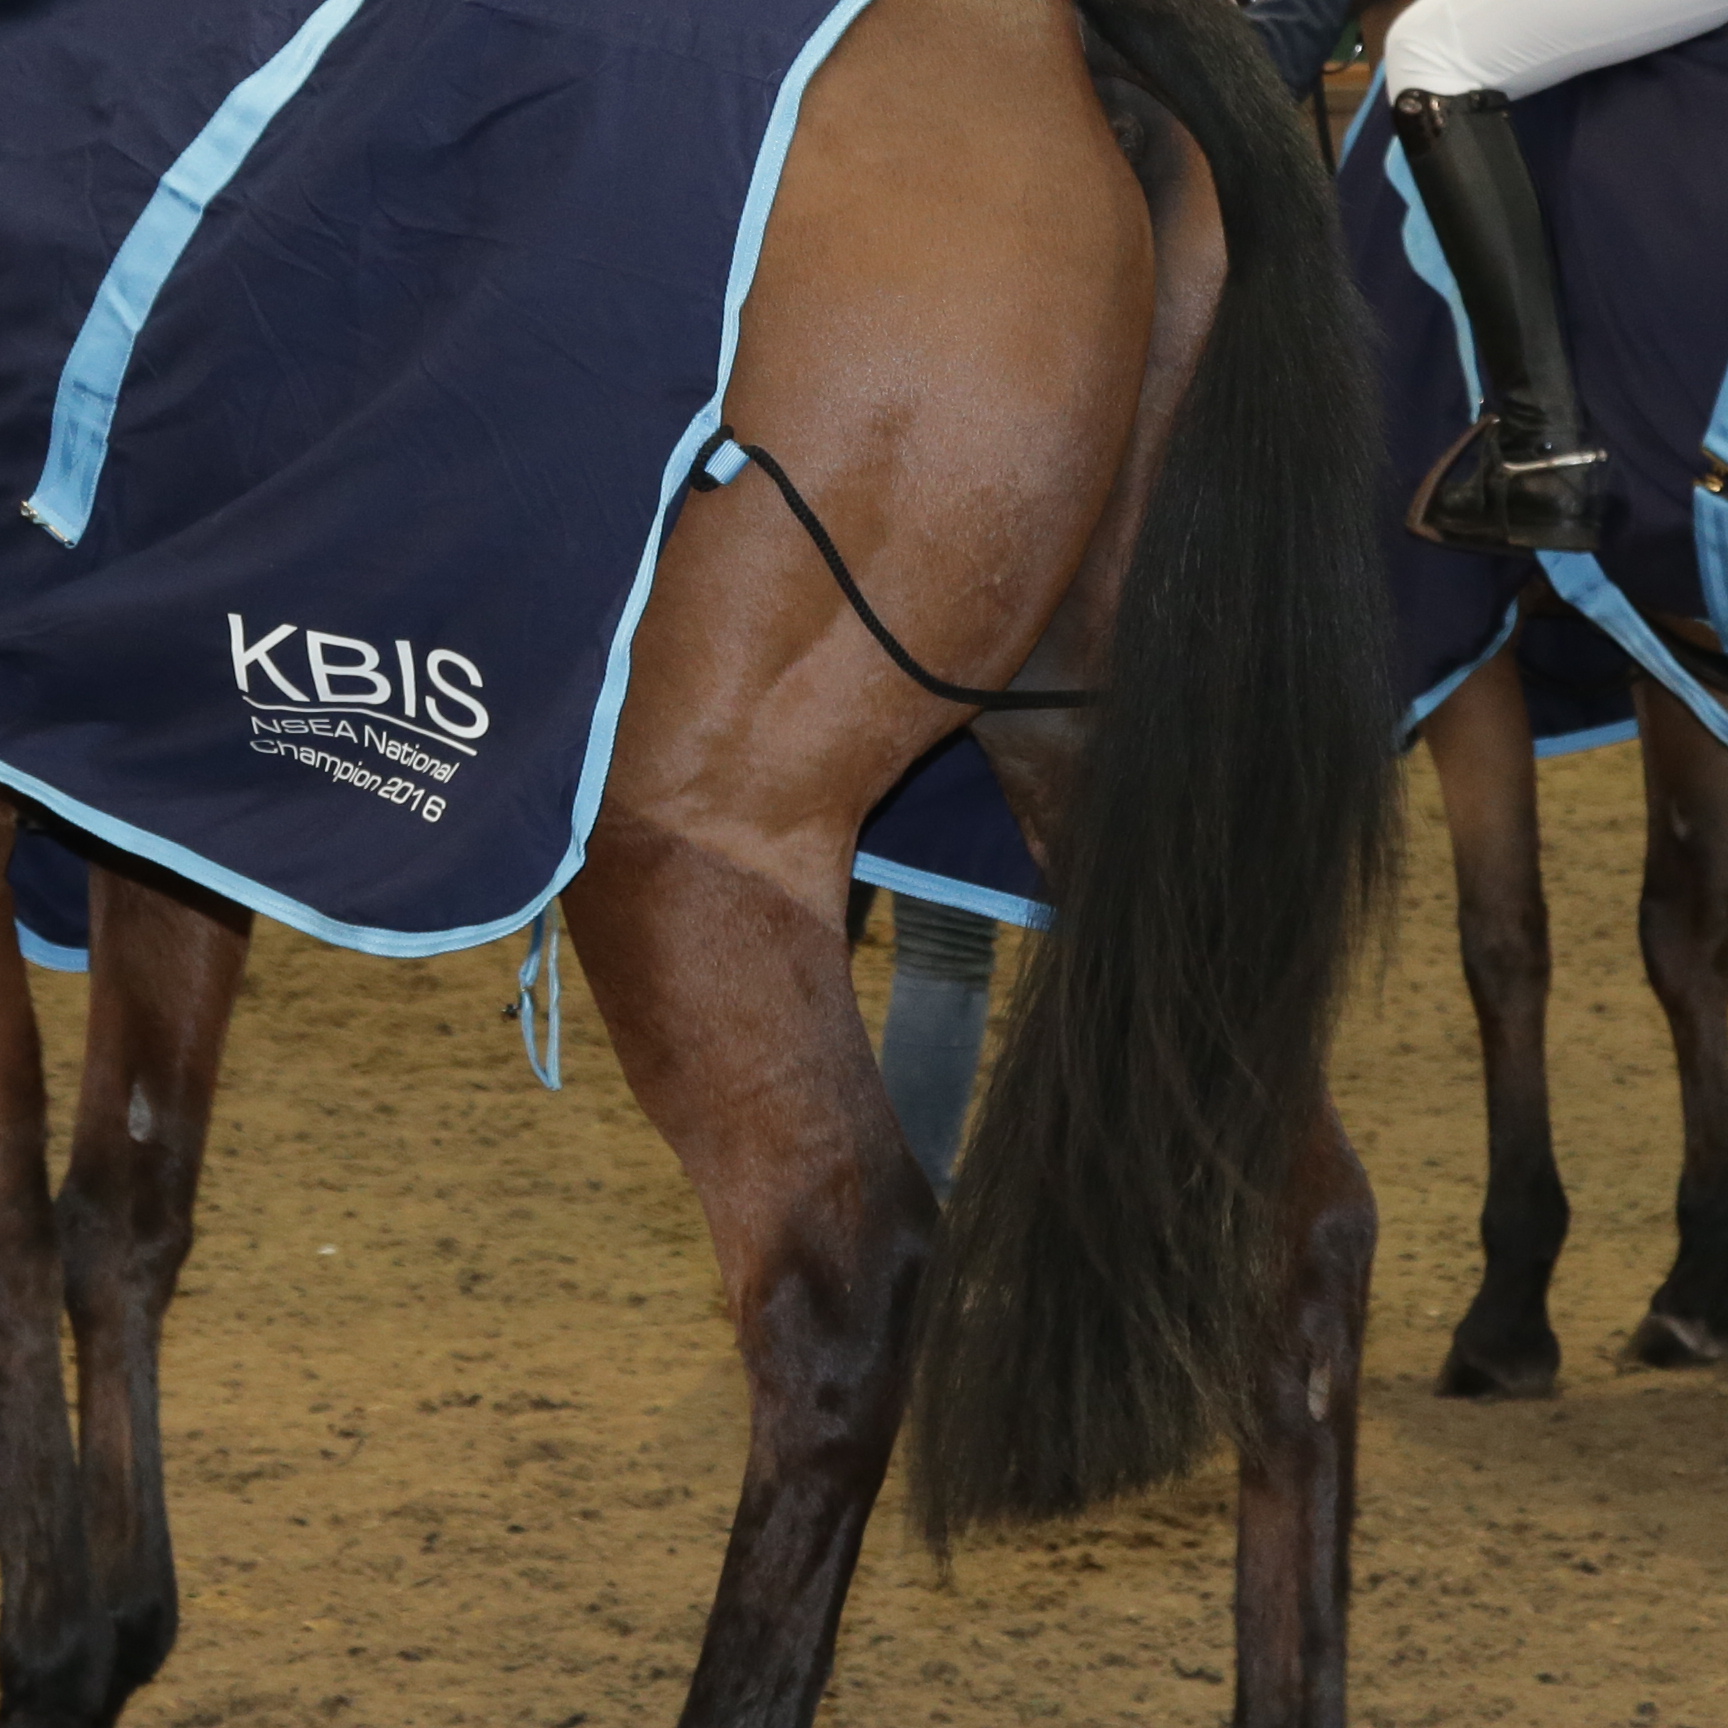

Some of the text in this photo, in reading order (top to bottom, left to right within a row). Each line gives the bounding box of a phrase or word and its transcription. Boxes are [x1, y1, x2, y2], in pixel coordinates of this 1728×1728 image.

[227, 612, 490, 740] KBIS
[249, 739, 447, 823] Champion 2016
[250, 715, 460, 784] NSEA National
